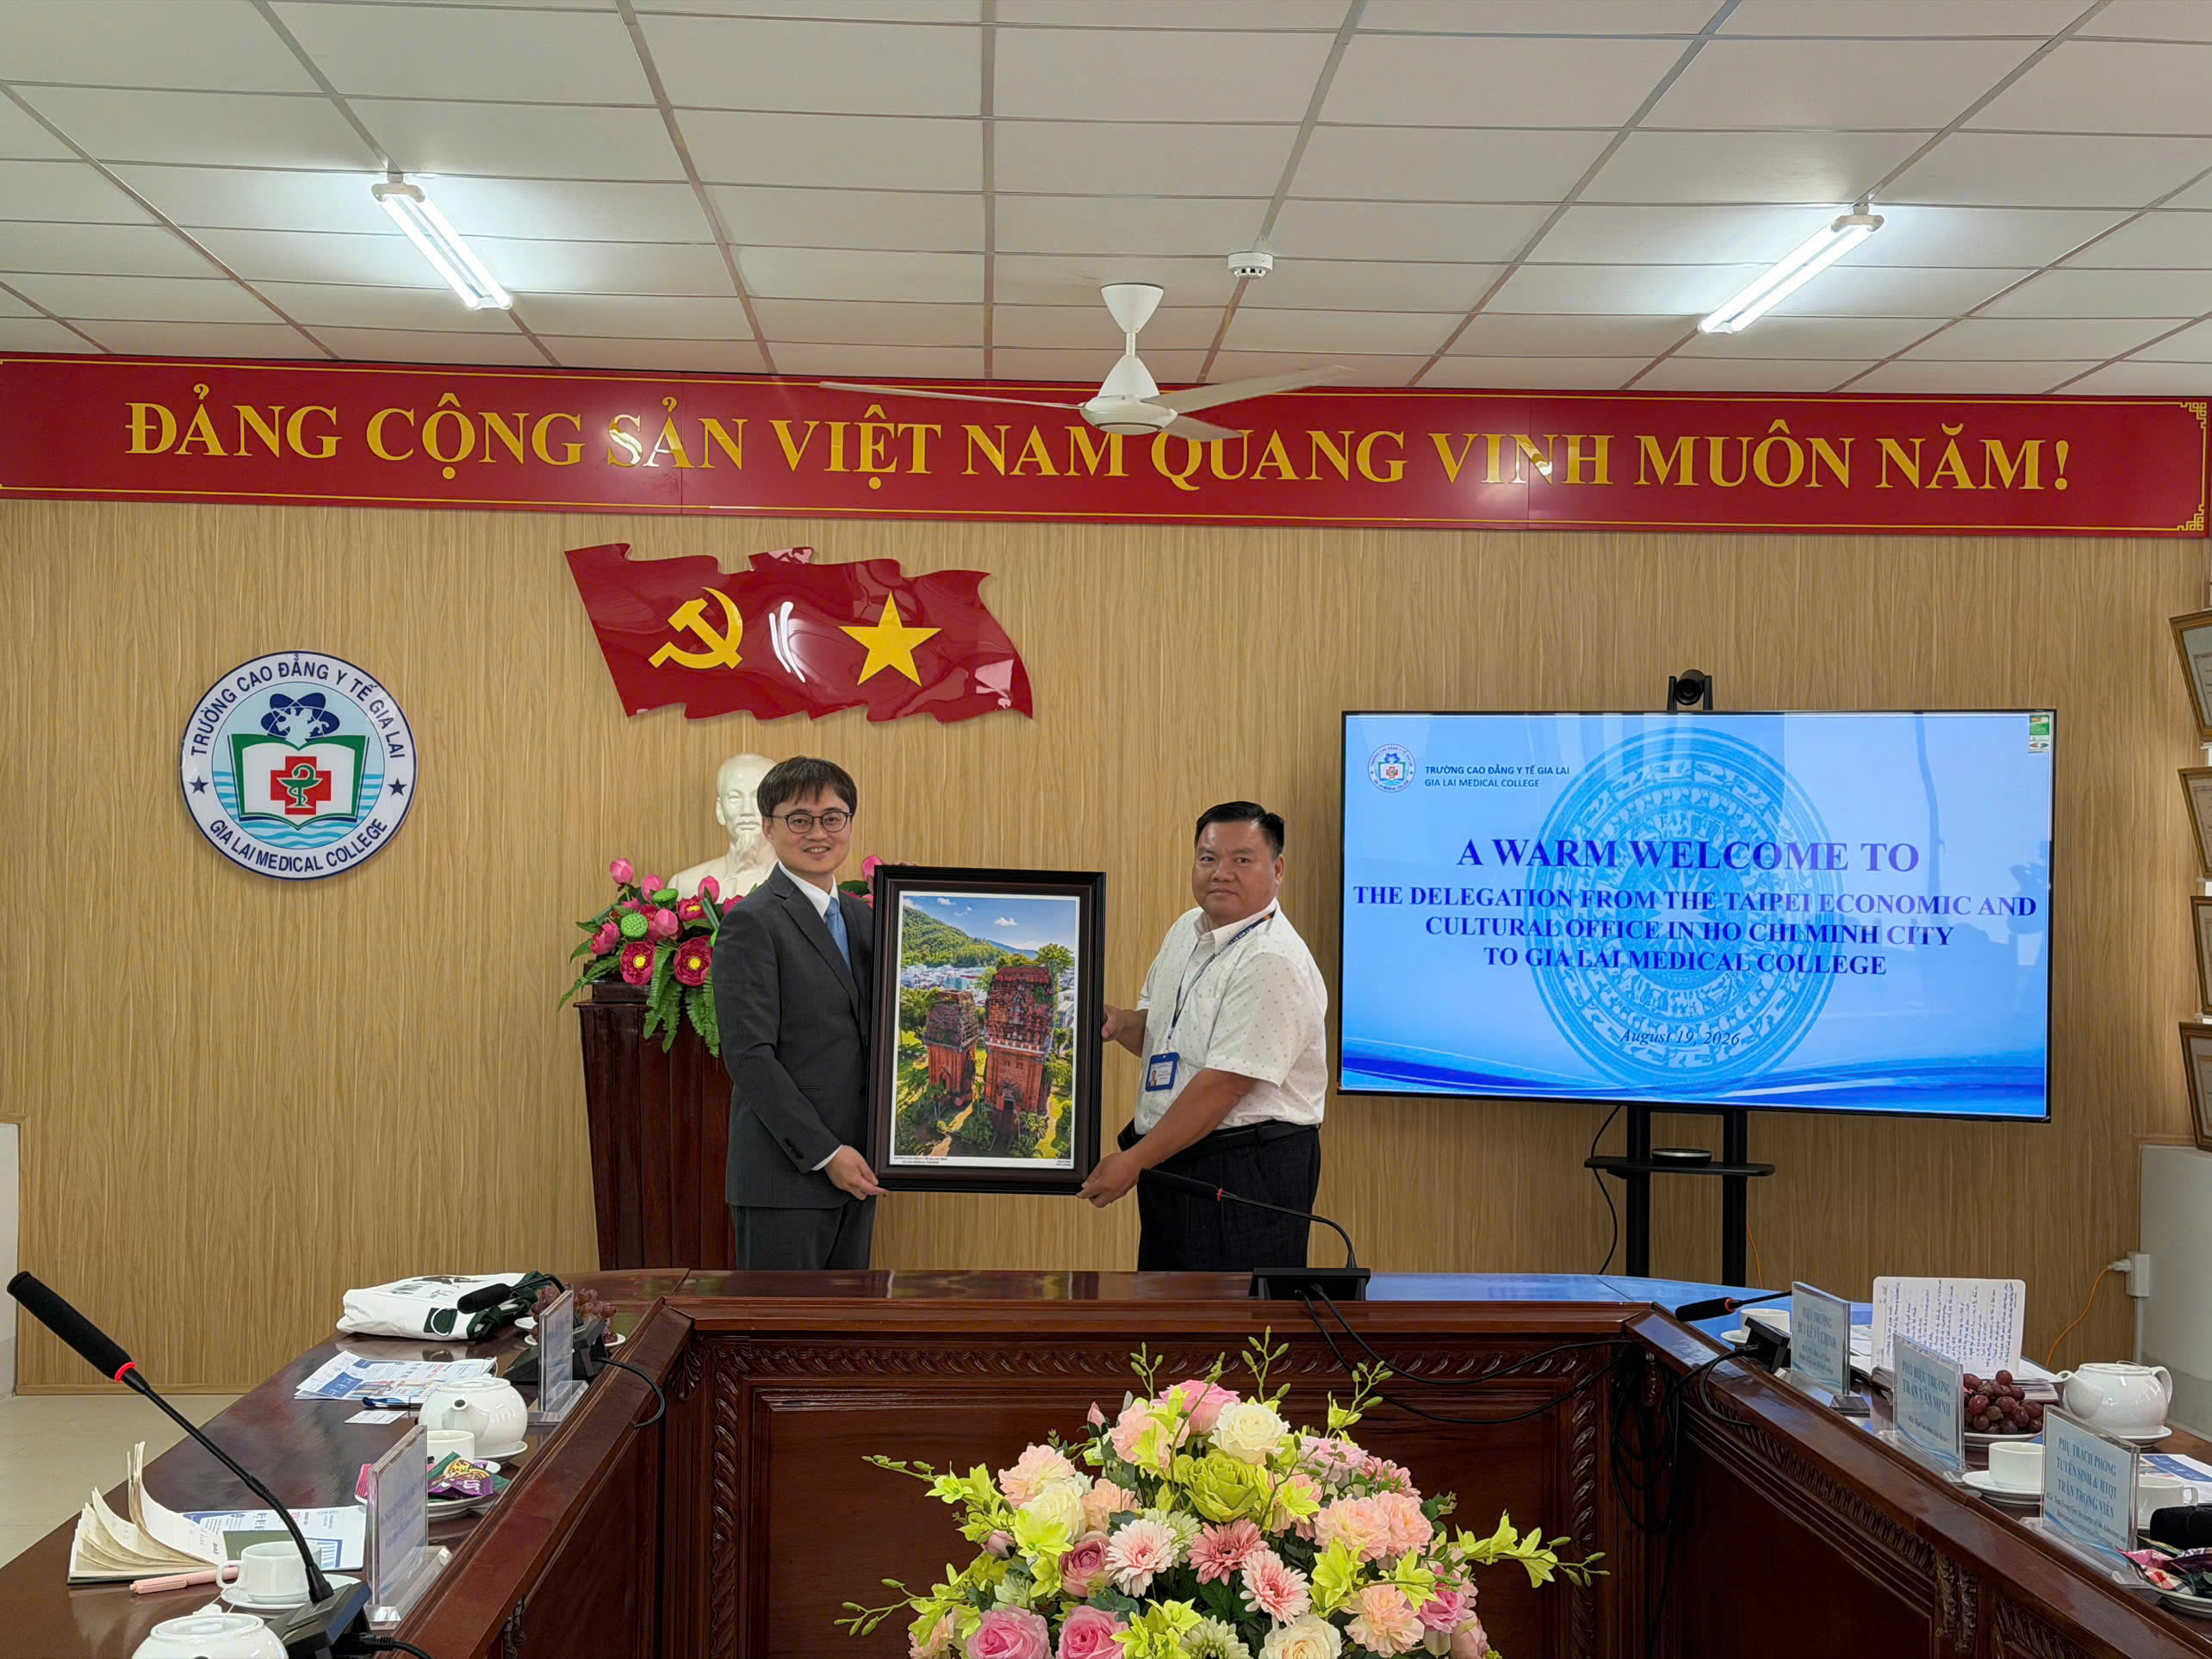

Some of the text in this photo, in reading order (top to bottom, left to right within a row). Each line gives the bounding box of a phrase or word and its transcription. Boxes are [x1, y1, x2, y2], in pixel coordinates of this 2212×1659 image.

[125, 382, 340, 459] ĐẢNG
[366, 392, 587, 480] CỘNG
[607, 397, 748, 469] SẢN
[771, 404, 941, 489] VIỆT
[961, 425, 1128, 476] NAM
[1151, 430, 1408, 491] QUANG
[1427, 432, 1613, 485] VINH
[1634, 419, 1854, 488] MUÔN
[191, 688, 237, 755] TRƯỜNG
[237, 666, 272, 693] CAO
[337, 668, 347, 685] Y
[349, 678, 377, 701] TẾ
[369, 699, 394, 730] GIA
[385, 730, 406, 759] LAI
[1425, 765, 1464, 774] TRƯỜNG
[1467, 766, 1486, 774] CAO
[1459, 779, 1499, 787] MEDICAL
[1501, 779, 1540, 787] COLLEGE
[209, 818, 388, 873] GIA LAI MEDICAL COLLEGE
[1456, 838, 1919, 873] A WARM WELCOME TO
[1353, 885, 2037, 916] THE DELEGATION FROM THE TAIPEI ECONOMIC AND
[1426, 916, 1954, 947] CULTURAL OFFICE IN HO CHI MINH CITY
[1484, 947, 1887, 975] TO GIA LAI MEDICAL COLLEGE
[1619, 1028, 1741, 1047] August 19, 2026
